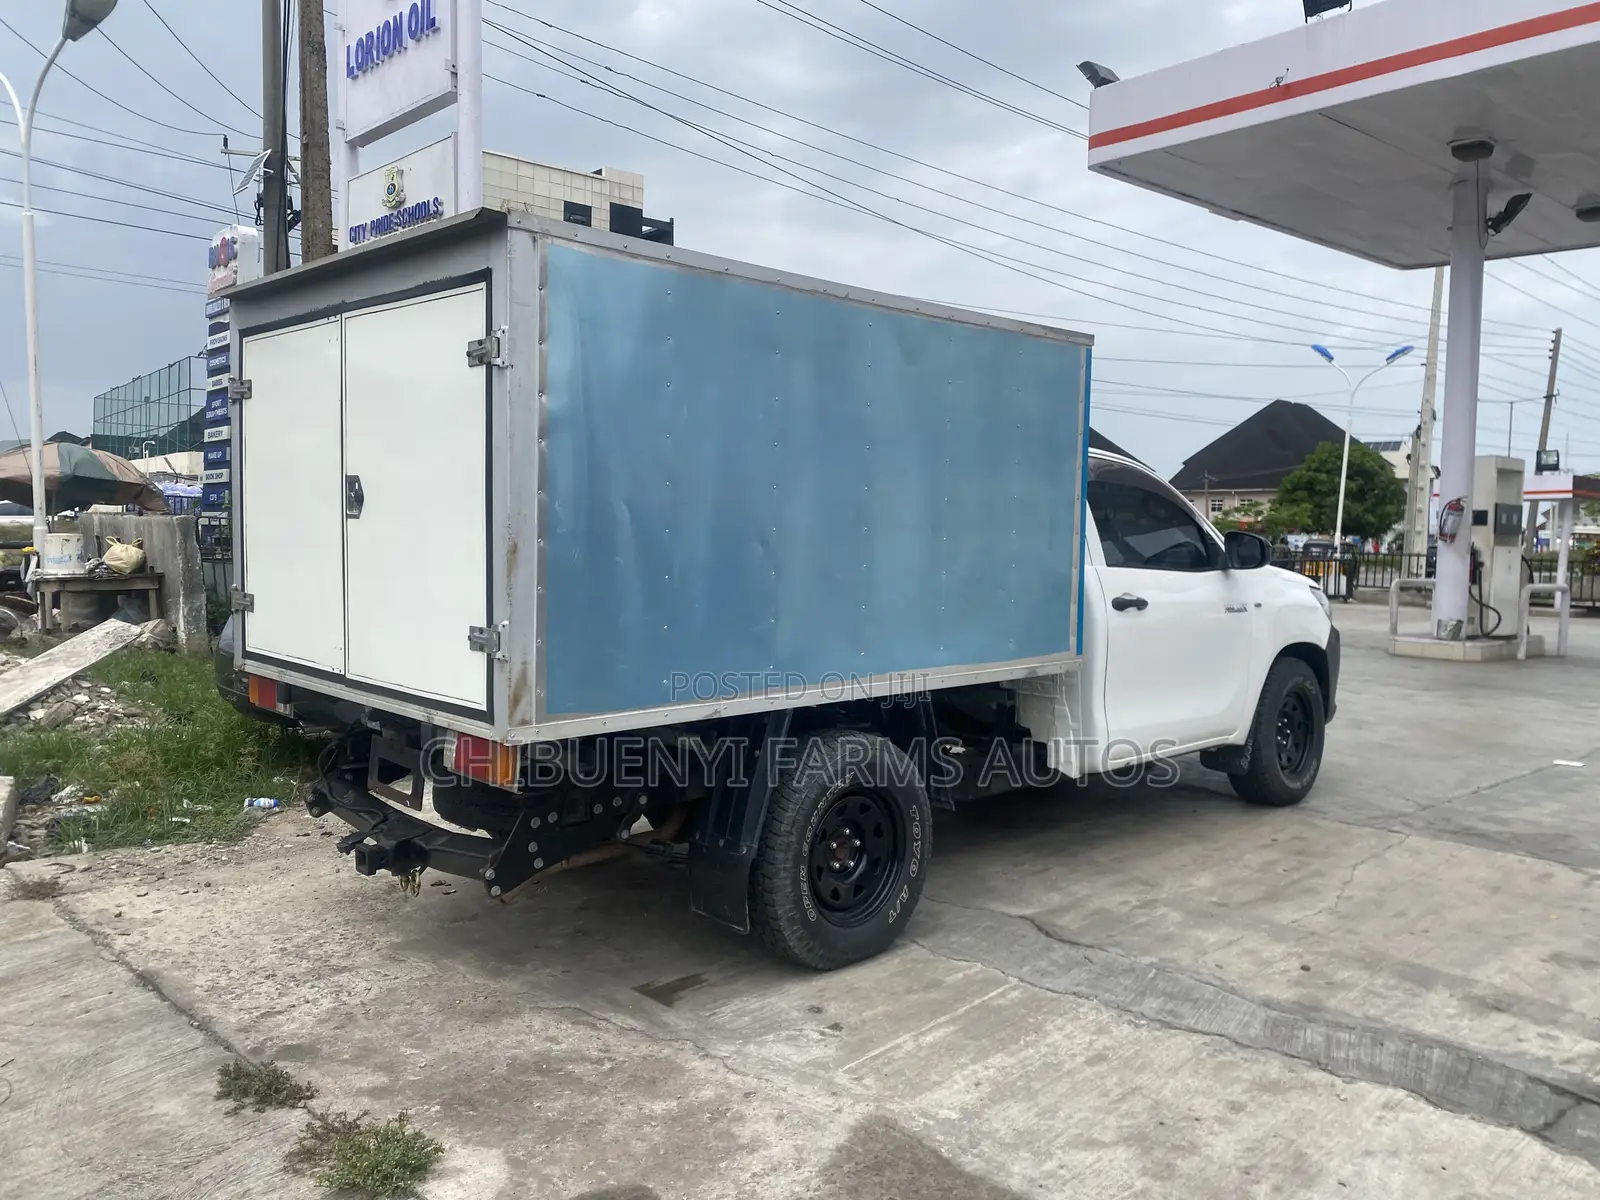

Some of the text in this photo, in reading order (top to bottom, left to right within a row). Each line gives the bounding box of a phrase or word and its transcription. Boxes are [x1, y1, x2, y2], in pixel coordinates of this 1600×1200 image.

[346, 0, 437, 79] LORION OIL
[349, 196, 441, 243] CITY PRIDE SCHOOLS
[209, 356, 227, 367] COSMETICS
[207, 431, 224, 439] BAKERY
[208, 452, 217, 460] MAKE
[205, 472, 224, 481] BOOK SHOP
[909, 805, 922, 878] TOYO
